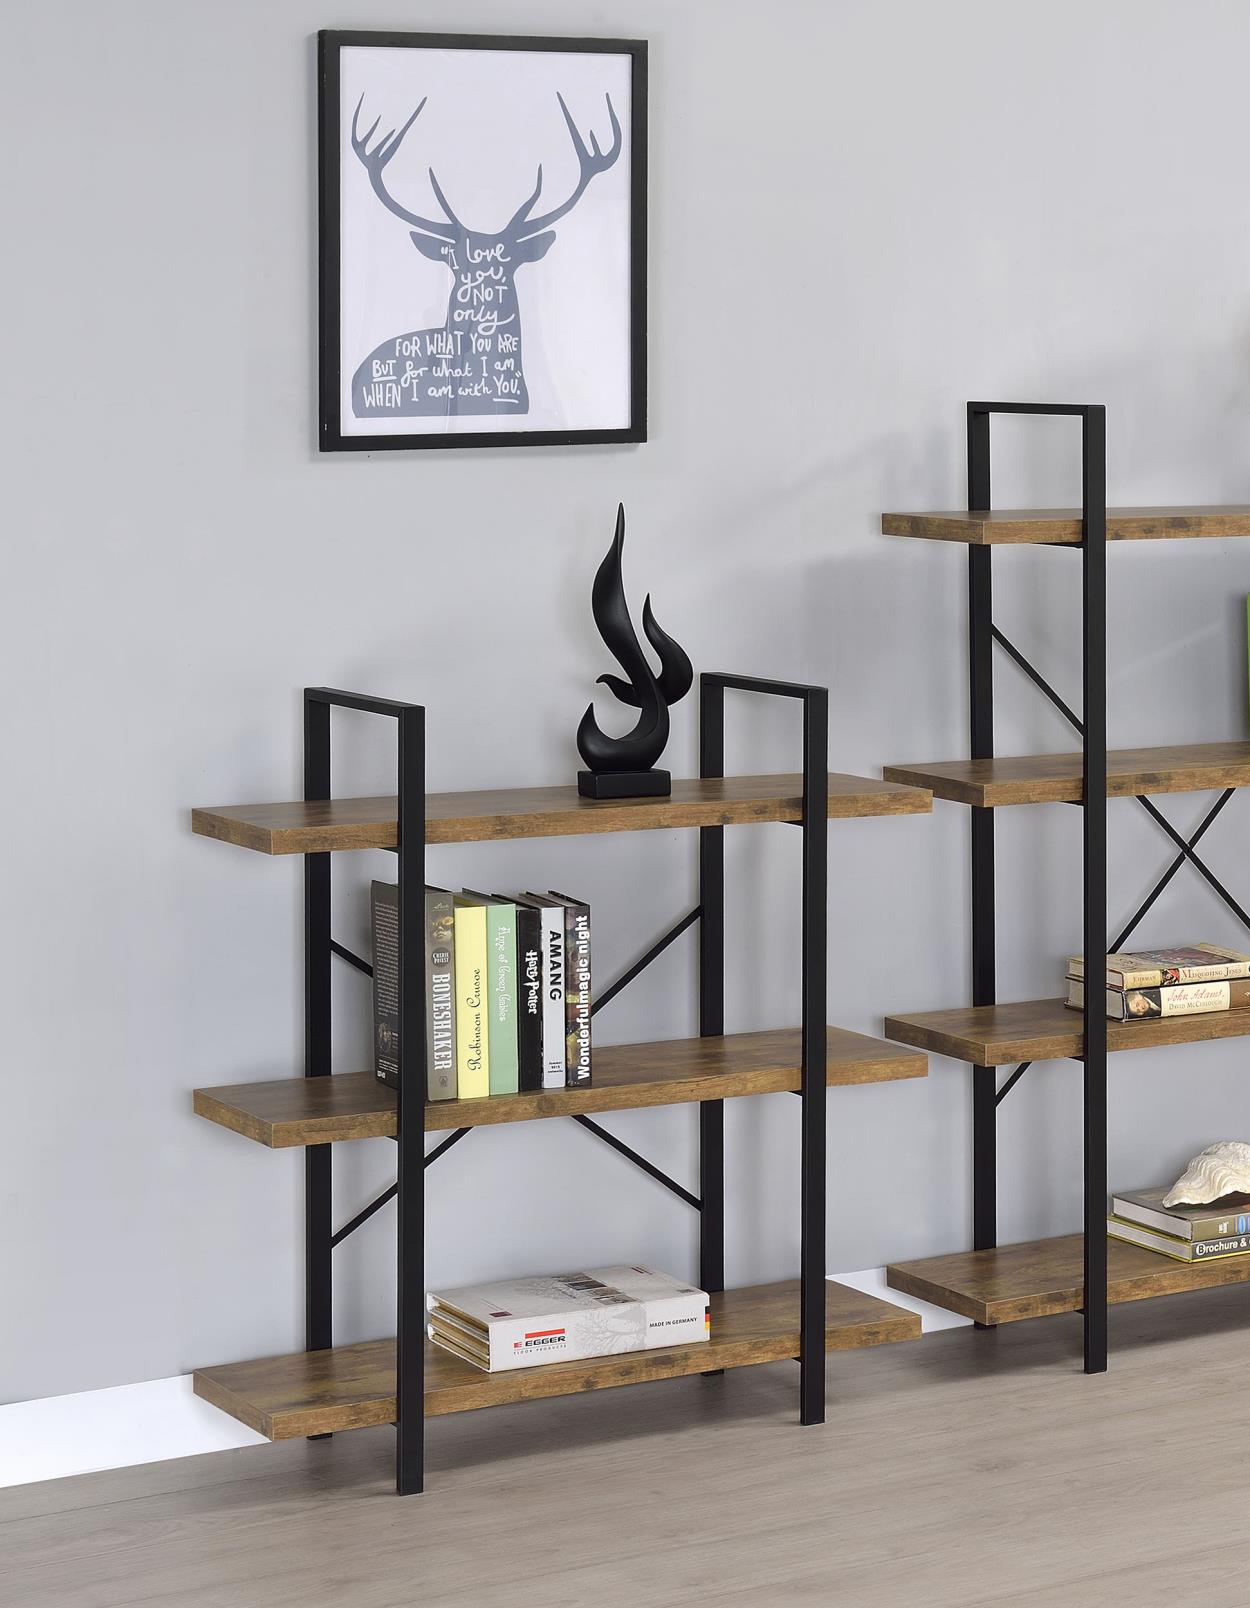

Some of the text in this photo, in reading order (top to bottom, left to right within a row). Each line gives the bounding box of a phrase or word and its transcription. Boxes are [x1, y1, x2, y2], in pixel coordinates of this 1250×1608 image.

[466, 237, 512, 264] love
[473, 283, 508, 306] NOT
[453, 305, 516, 336] only
[395, 330, 520, 358] FOR WHAT YOU ARE
[372, 356, 515, 388] BUT for what I am
[362, 383, 401, 408] WHEN
[411, 379, 419, 402] I
[428, 385, 455, 399] am
[458, 377, 492, 397] with
[575, 915, 591, 954] night
[498, 954, 508, 964] of
[549, 930, 562, 1001] AMANG
[523, 950, 540, 1014] Harry Potter
[1167, 989, 1188, 1002] John
[432, 973, 453, 1071] BONESHAKER
[466, 968, 482, 1071] Robinson Crusoe
[499, 993, 511, 1022] Gables
[1195, 1240, 1239, 1256] Brochure
[1240, 1237, 1247, 1247] &
[671, 1317, 698, 1326] GERMANY
[525, 1335, 566, 1347] EGGER
